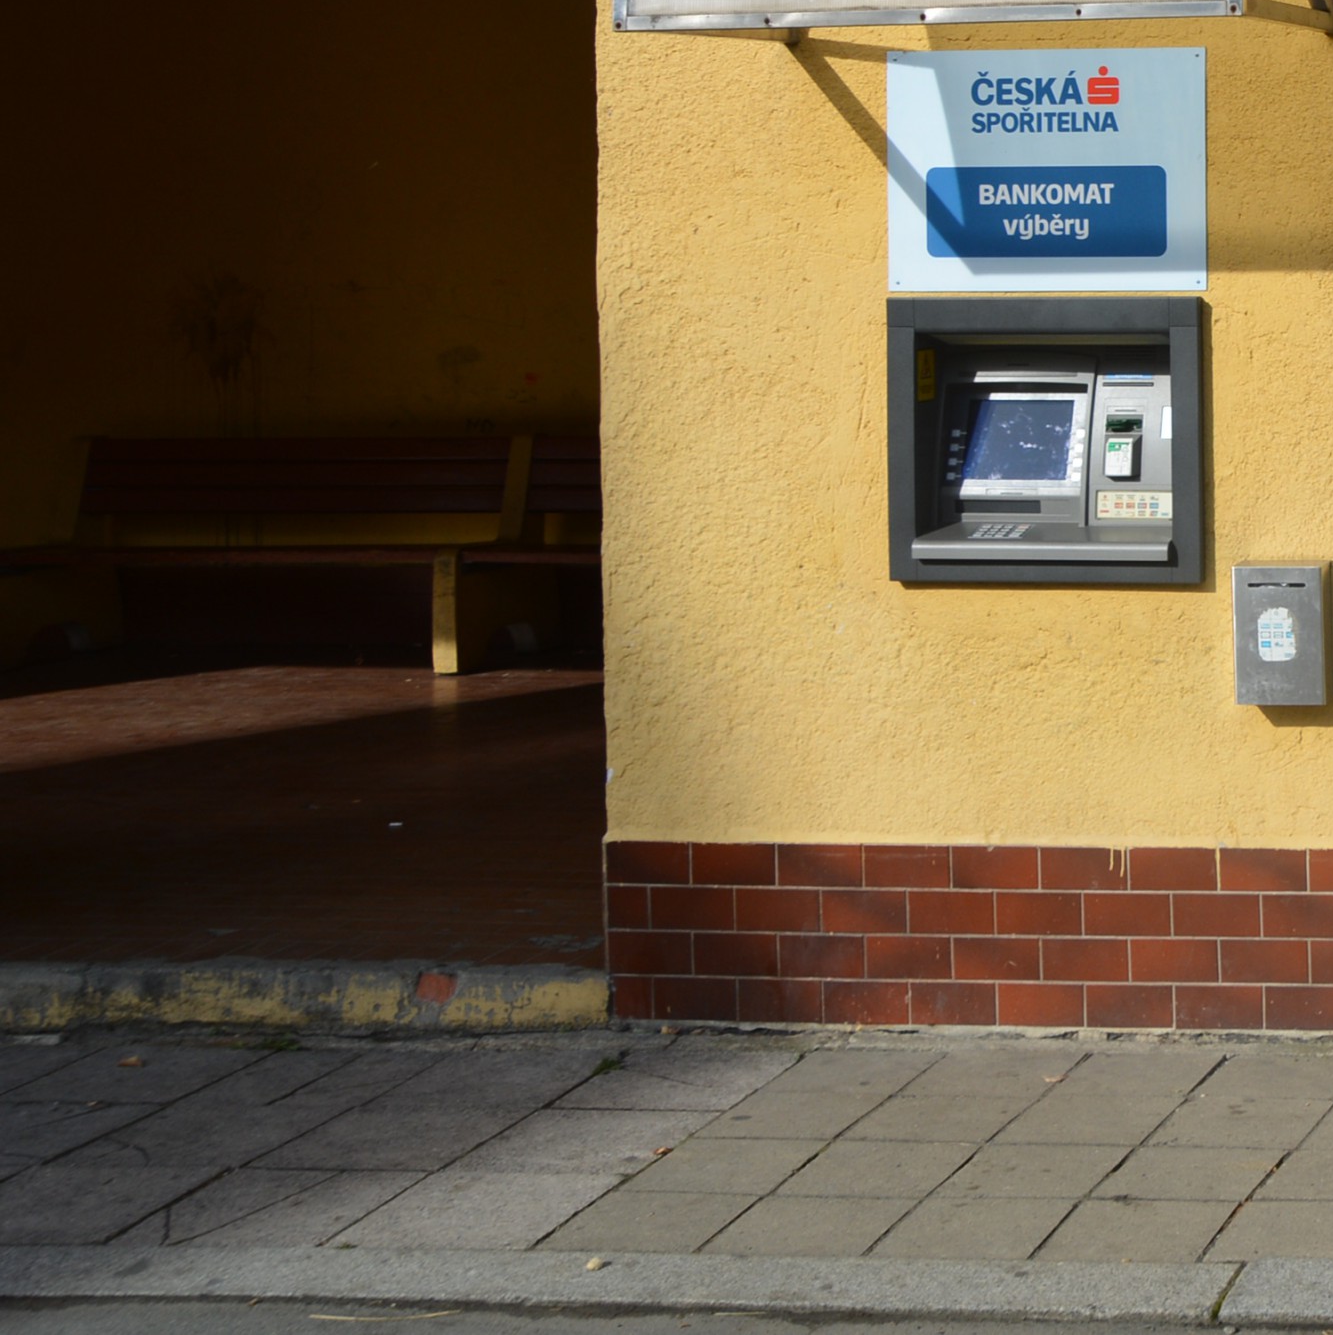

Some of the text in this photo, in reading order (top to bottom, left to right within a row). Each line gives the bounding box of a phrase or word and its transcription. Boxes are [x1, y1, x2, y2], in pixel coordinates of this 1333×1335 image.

[970, 70, 1083, 106] ČESKÁ
[971, 107, 1120, 134] SPOŘITELNA
[978, 183, 1115, 205] BANKOMAT
[1003, 213, 1090, 240] výběry
